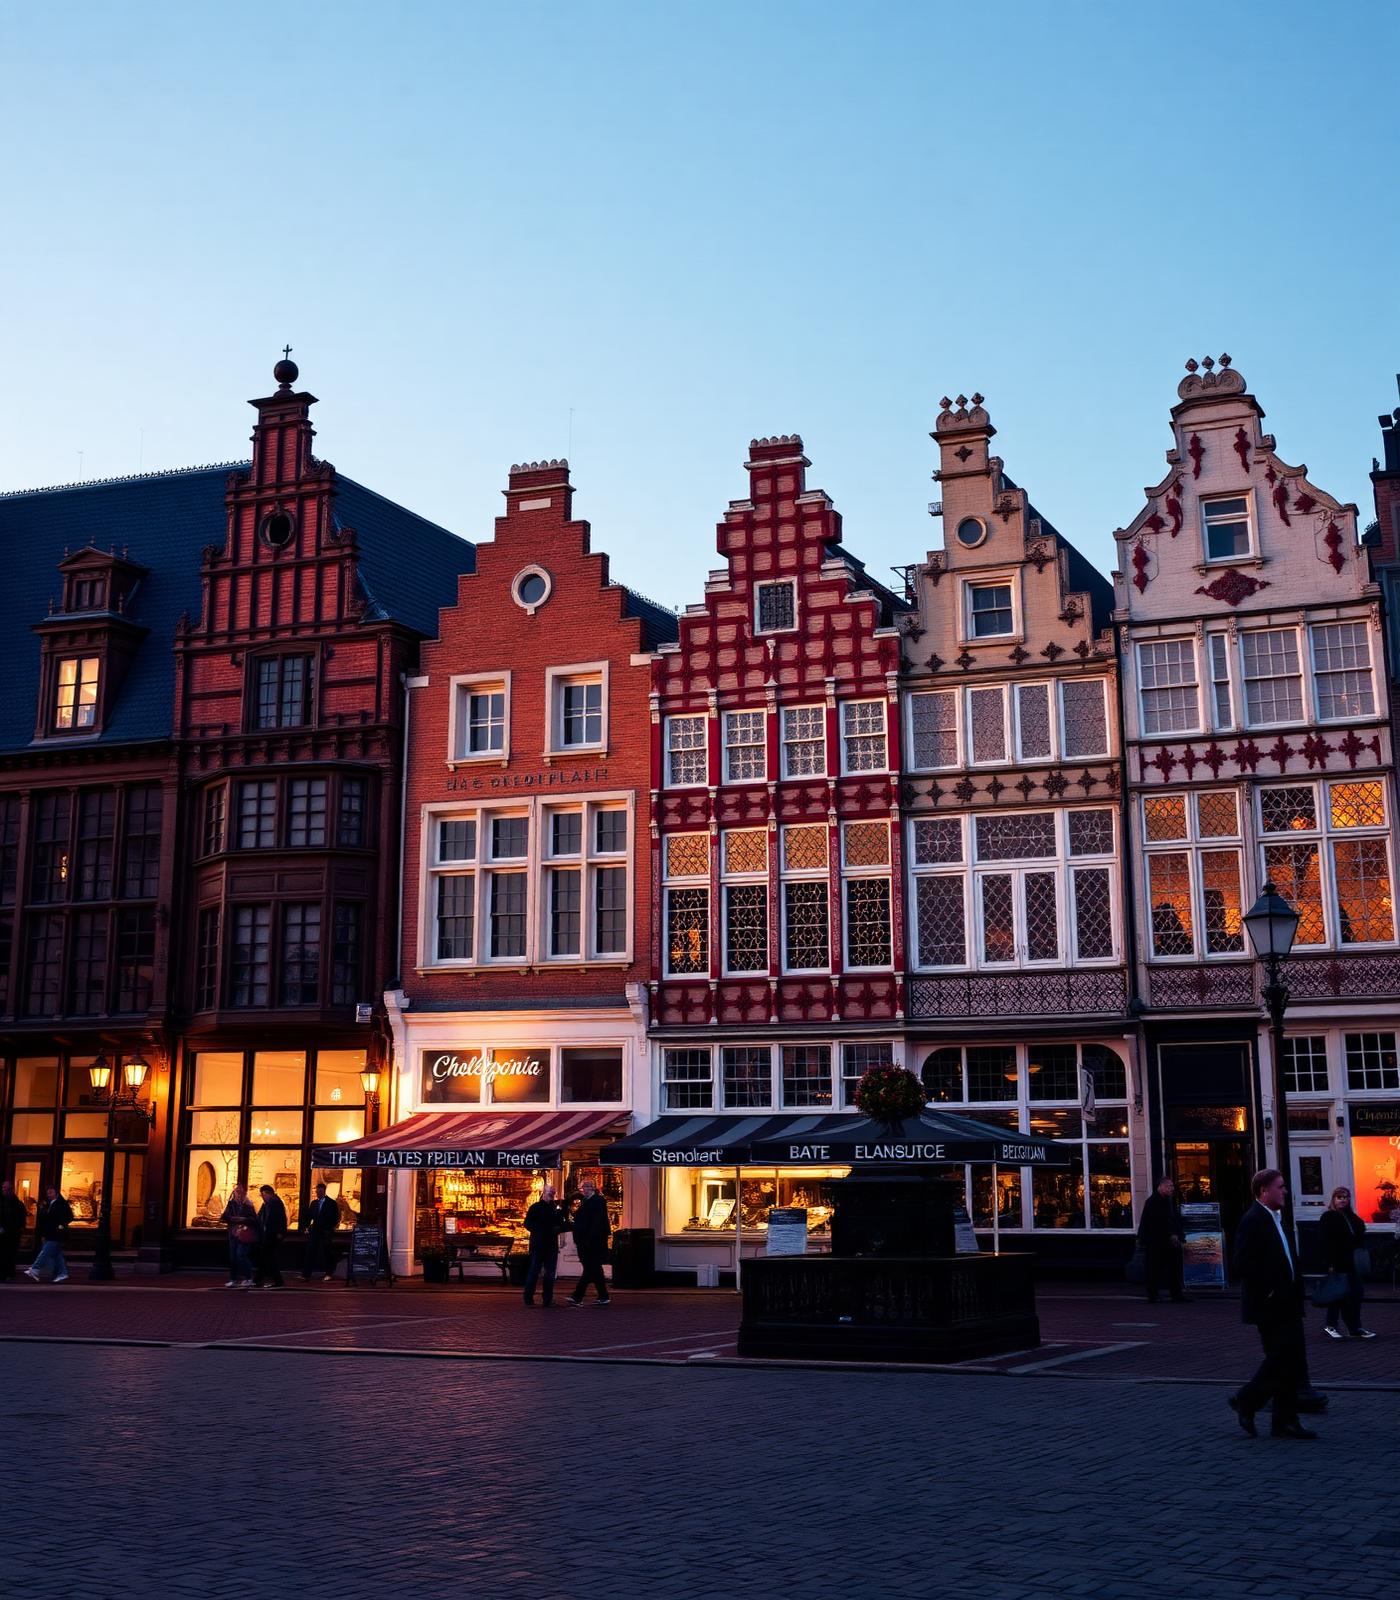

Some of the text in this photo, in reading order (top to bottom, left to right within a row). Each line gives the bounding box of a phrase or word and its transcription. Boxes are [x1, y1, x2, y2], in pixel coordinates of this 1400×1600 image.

[329, 1151, 358, 1165] THE
[376, 1151, 423, 1166] BATES
[788, 1143, 946, 1160] BATE ELANSUTCE
